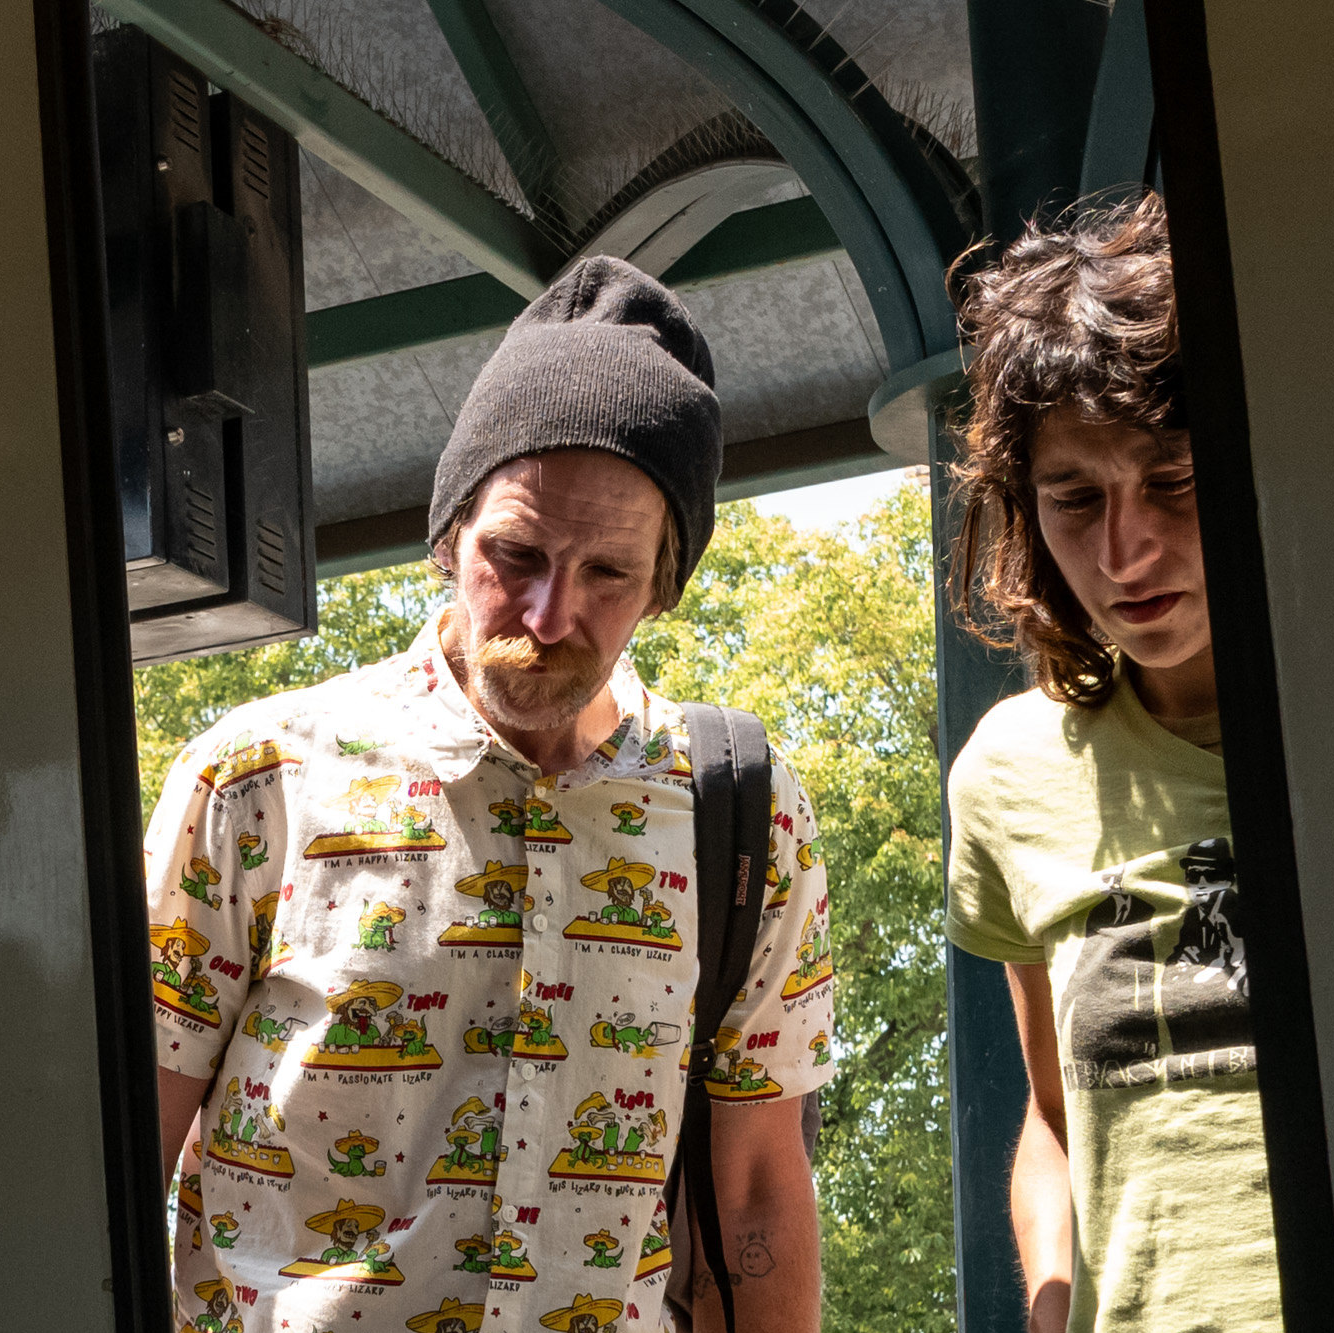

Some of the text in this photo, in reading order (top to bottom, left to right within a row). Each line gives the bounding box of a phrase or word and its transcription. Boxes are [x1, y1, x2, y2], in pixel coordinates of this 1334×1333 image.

[408, 779, 442, 797] ONE
[525, 844, 556, 854] LIZARD
[324, 852, 429, 869] I'M A HAPPY LIZARD
[659, 870, 688, 893] TWO
[450, 949, 521, 961] I'M A CLASSY
[575, 943, 673, 962] I'M A CLASSY LIZARD
[209, 955, 245, 980] ONE
[535, 982, 574, 1002] THREE
[407, 991, 449, 1012] THREE
[174, 1014, 205, 1034] LIZARD
[747, 1029, 780, 1050] ONE
[303, 1070, 432, 1085] I'M A PASSIONATE LIZARD
[614, 1088, 655, 1110] FLOOR
[427, 1186, 489, 1201] THIS LIZARD IS
[549, 1181, 634, 1197] THIS LIZARD IS BUCK
[236, 1284, 258, 1306] TWO
[350, 1284, 385, 1296] LIZARD
[490, 1281, 521, 1292] LIZARD
